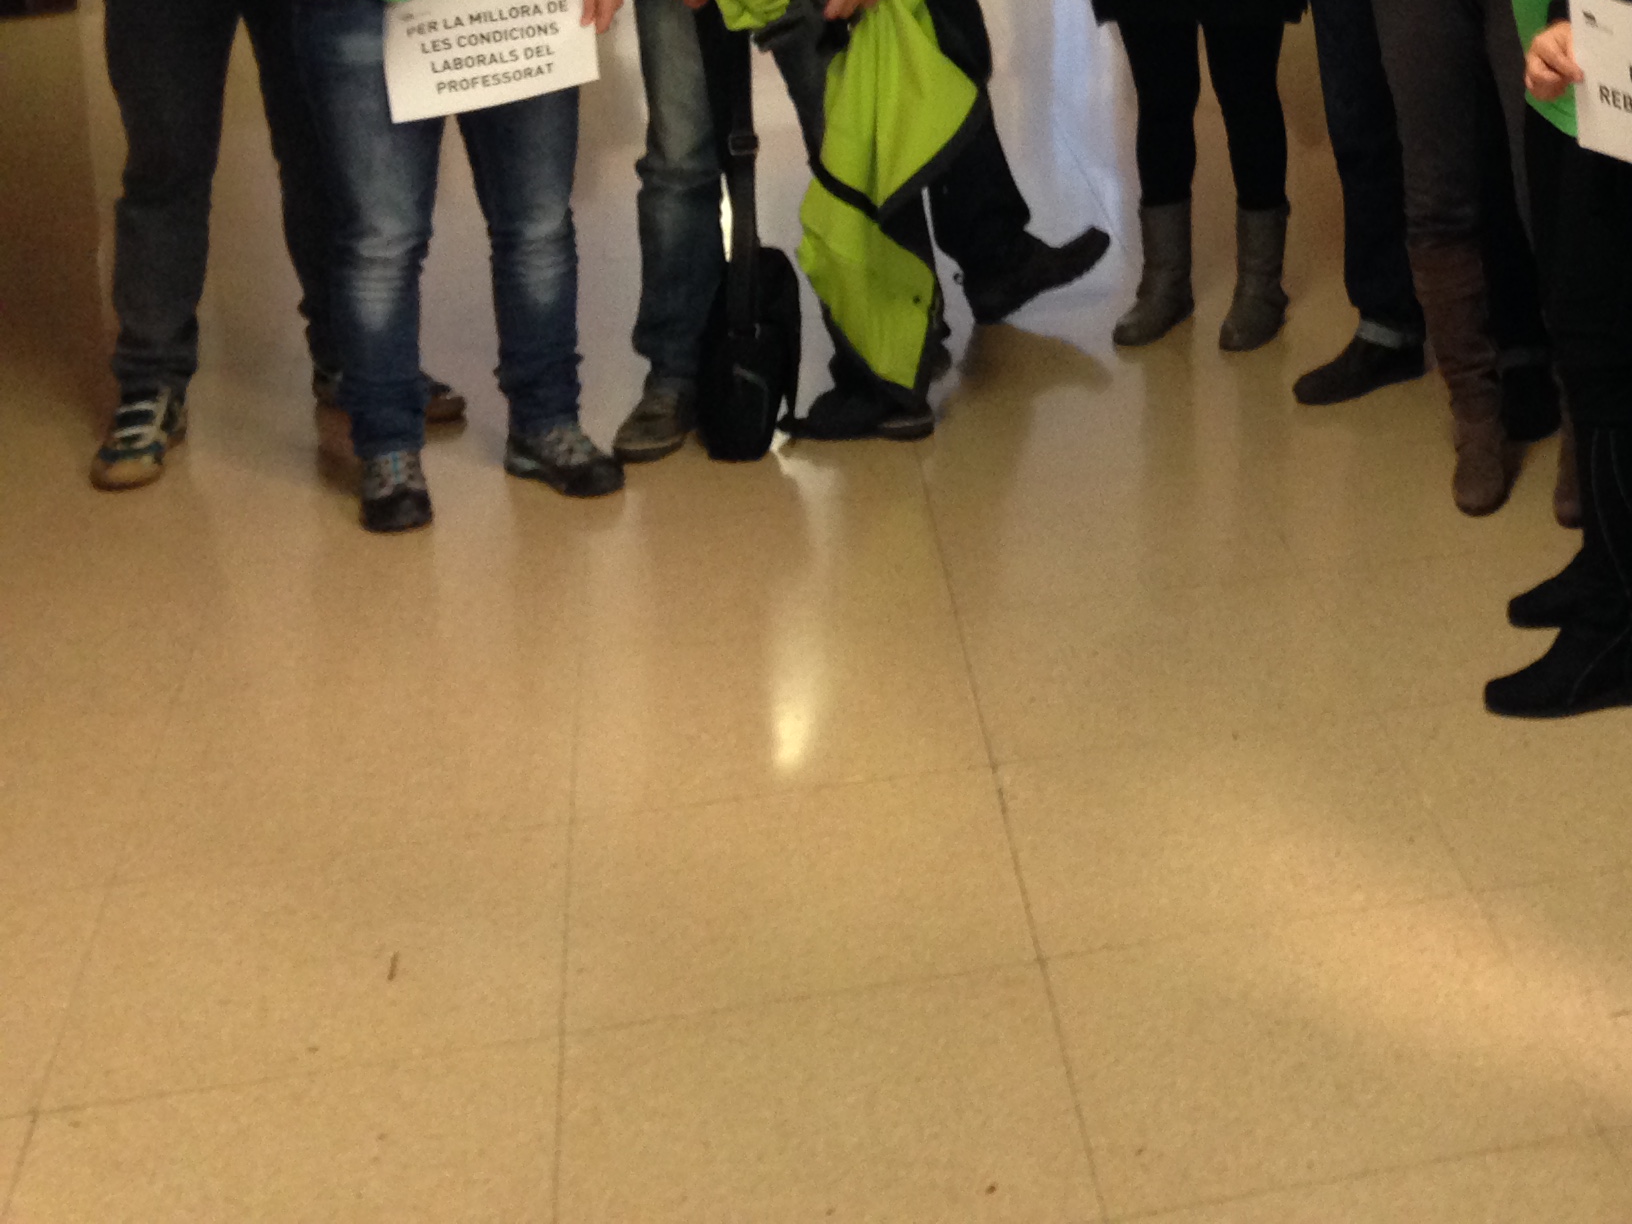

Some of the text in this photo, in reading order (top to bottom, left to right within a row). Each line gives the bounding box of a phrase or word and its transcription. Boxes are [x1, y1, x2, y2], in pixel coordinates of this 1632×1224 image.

[406, 21, 438, 38] PER
[443, 16, 464, 30] LA
[469, 3, 543, 25] MILLORA
[547, 0, 569, 14] DE
[421, 22, 560, 54] LES CONDICIONS
[430, 45, 555, 74] LABORALS DEL
[436, 62, 554, 95] PROFESSORAT
